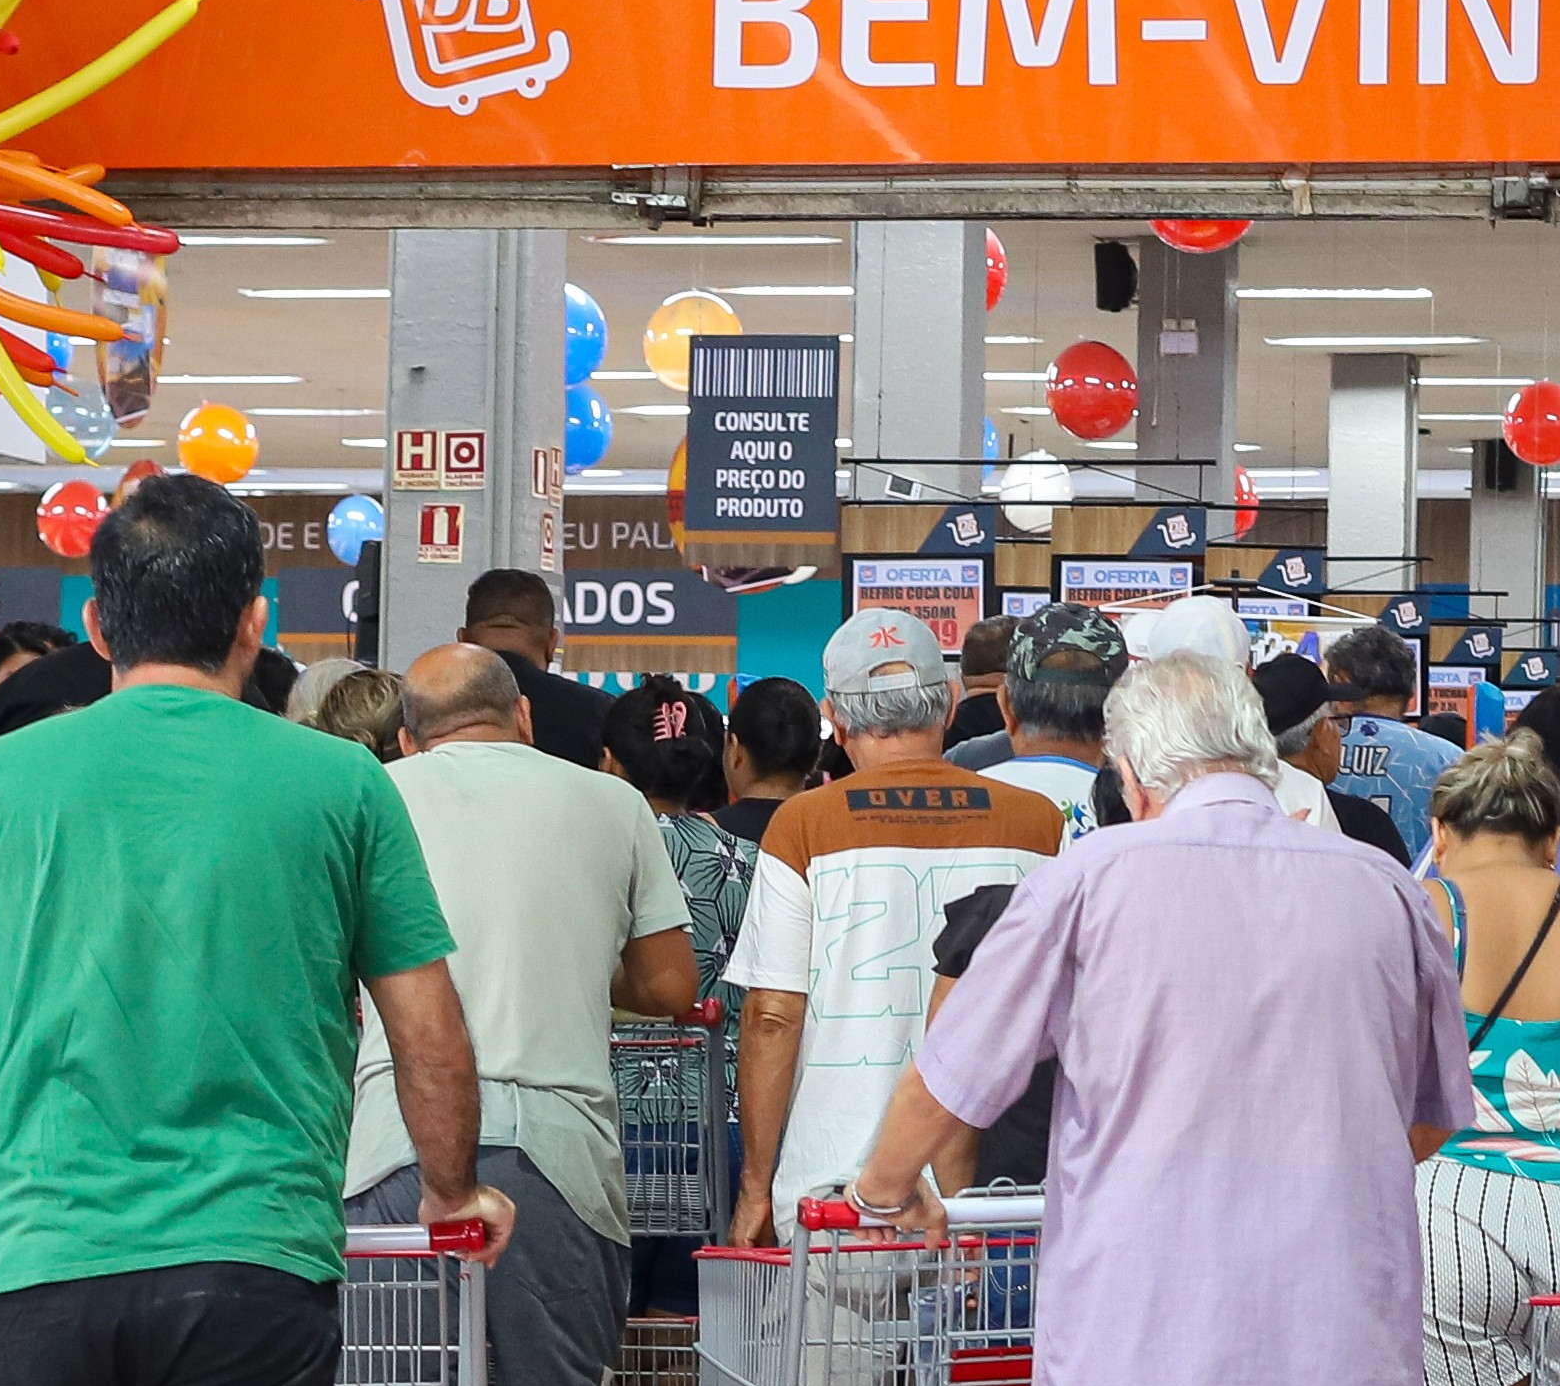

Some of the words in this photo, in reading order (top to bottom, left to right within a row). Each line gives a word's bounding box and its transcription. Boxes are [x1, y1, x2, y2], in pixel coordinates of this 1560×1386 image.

[715, 412, 810, 432] CONSULTE
[730, 441, 775, 464] AQUI
[779, 441, 793, 460] O
[716, 469, 775, 494] PREÇO
[779, 469, 805, 489] DO
[716, 497, 803, 518] PRODUTO
[887, 568, 952, 582] OFERTA
[1094, 570, 1160, 583] OFERTA
[861, 587, 903, 600] REFRIG
[907, 587, 940, 600] COCA
[944, 587, 974, 600] COLA
[1069, 588, 1111, 601] REFRIG
[1340, 745, 1390, 776] LUIZ
[868, 790, 969, 807] OVER
